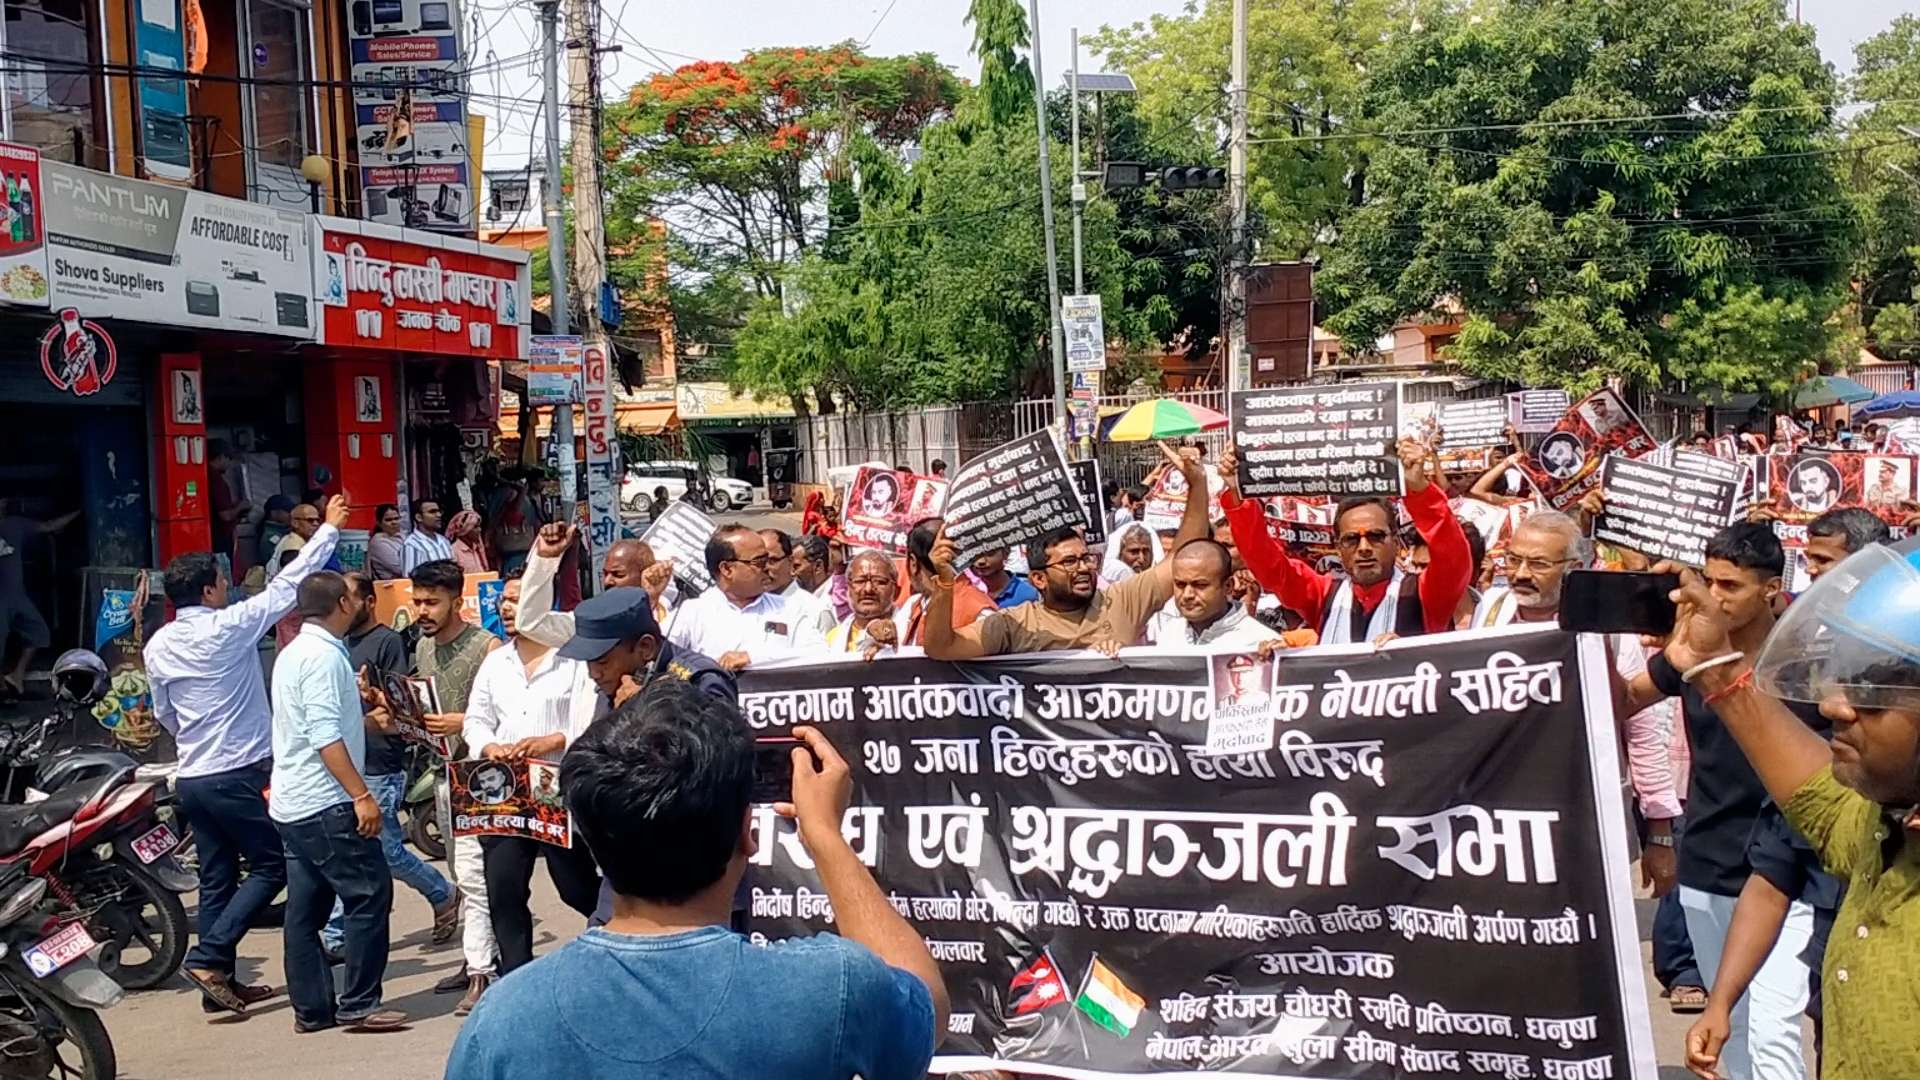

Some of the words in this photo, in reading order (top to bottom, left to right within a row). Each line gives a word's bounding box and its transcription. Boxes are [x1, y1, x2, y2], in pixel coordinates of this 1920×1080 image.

[51, 172, 170, 219] PANTUM
[190, 216, 260, 247] AFFORDABLE
[262, 230, 289, 256] COST
[55, 258, 99, 281] Shova
[102, 266, 165, 293] Suppliers
[863, 675, 1026, 721] आतंकवादी
[1321, 662, 1442, 721] नेपाली
[1450, 650, 1563, 714] सहित
[863, 739, 901, 775] २७
[911, 739, 981, 775] जना
[1182, 744, 1276, 781] हत्या
[493, 815, 525, 829] हत्या
[904, 793, 990, 869] एवं
[1376, 804, 1561, 884] सभा
[910, 890, 963, 921] हत्याको
[1082, 904, 1097, 929] र
[1098, 906, 1130, 931] उक्त
[1318, 904, 1383, 935] हार्दिक
[1472, 909, 1527, 945] अर्पण
[924, 936, 987, 964] ंगलवार
[1255, 946, 1396, 979] आयोजक
[1159, 992, 1211, 1023] शहिद
[1212, 990, 1277, 1018] संजय
[1358, 993, 1410, 1030] स्मृति
[1343, 1031, 1397, 1066] सीमा
[1401, 1043, 1460, 1073] संवाद
[1541, 1055, 1613, 1080] धनषा
